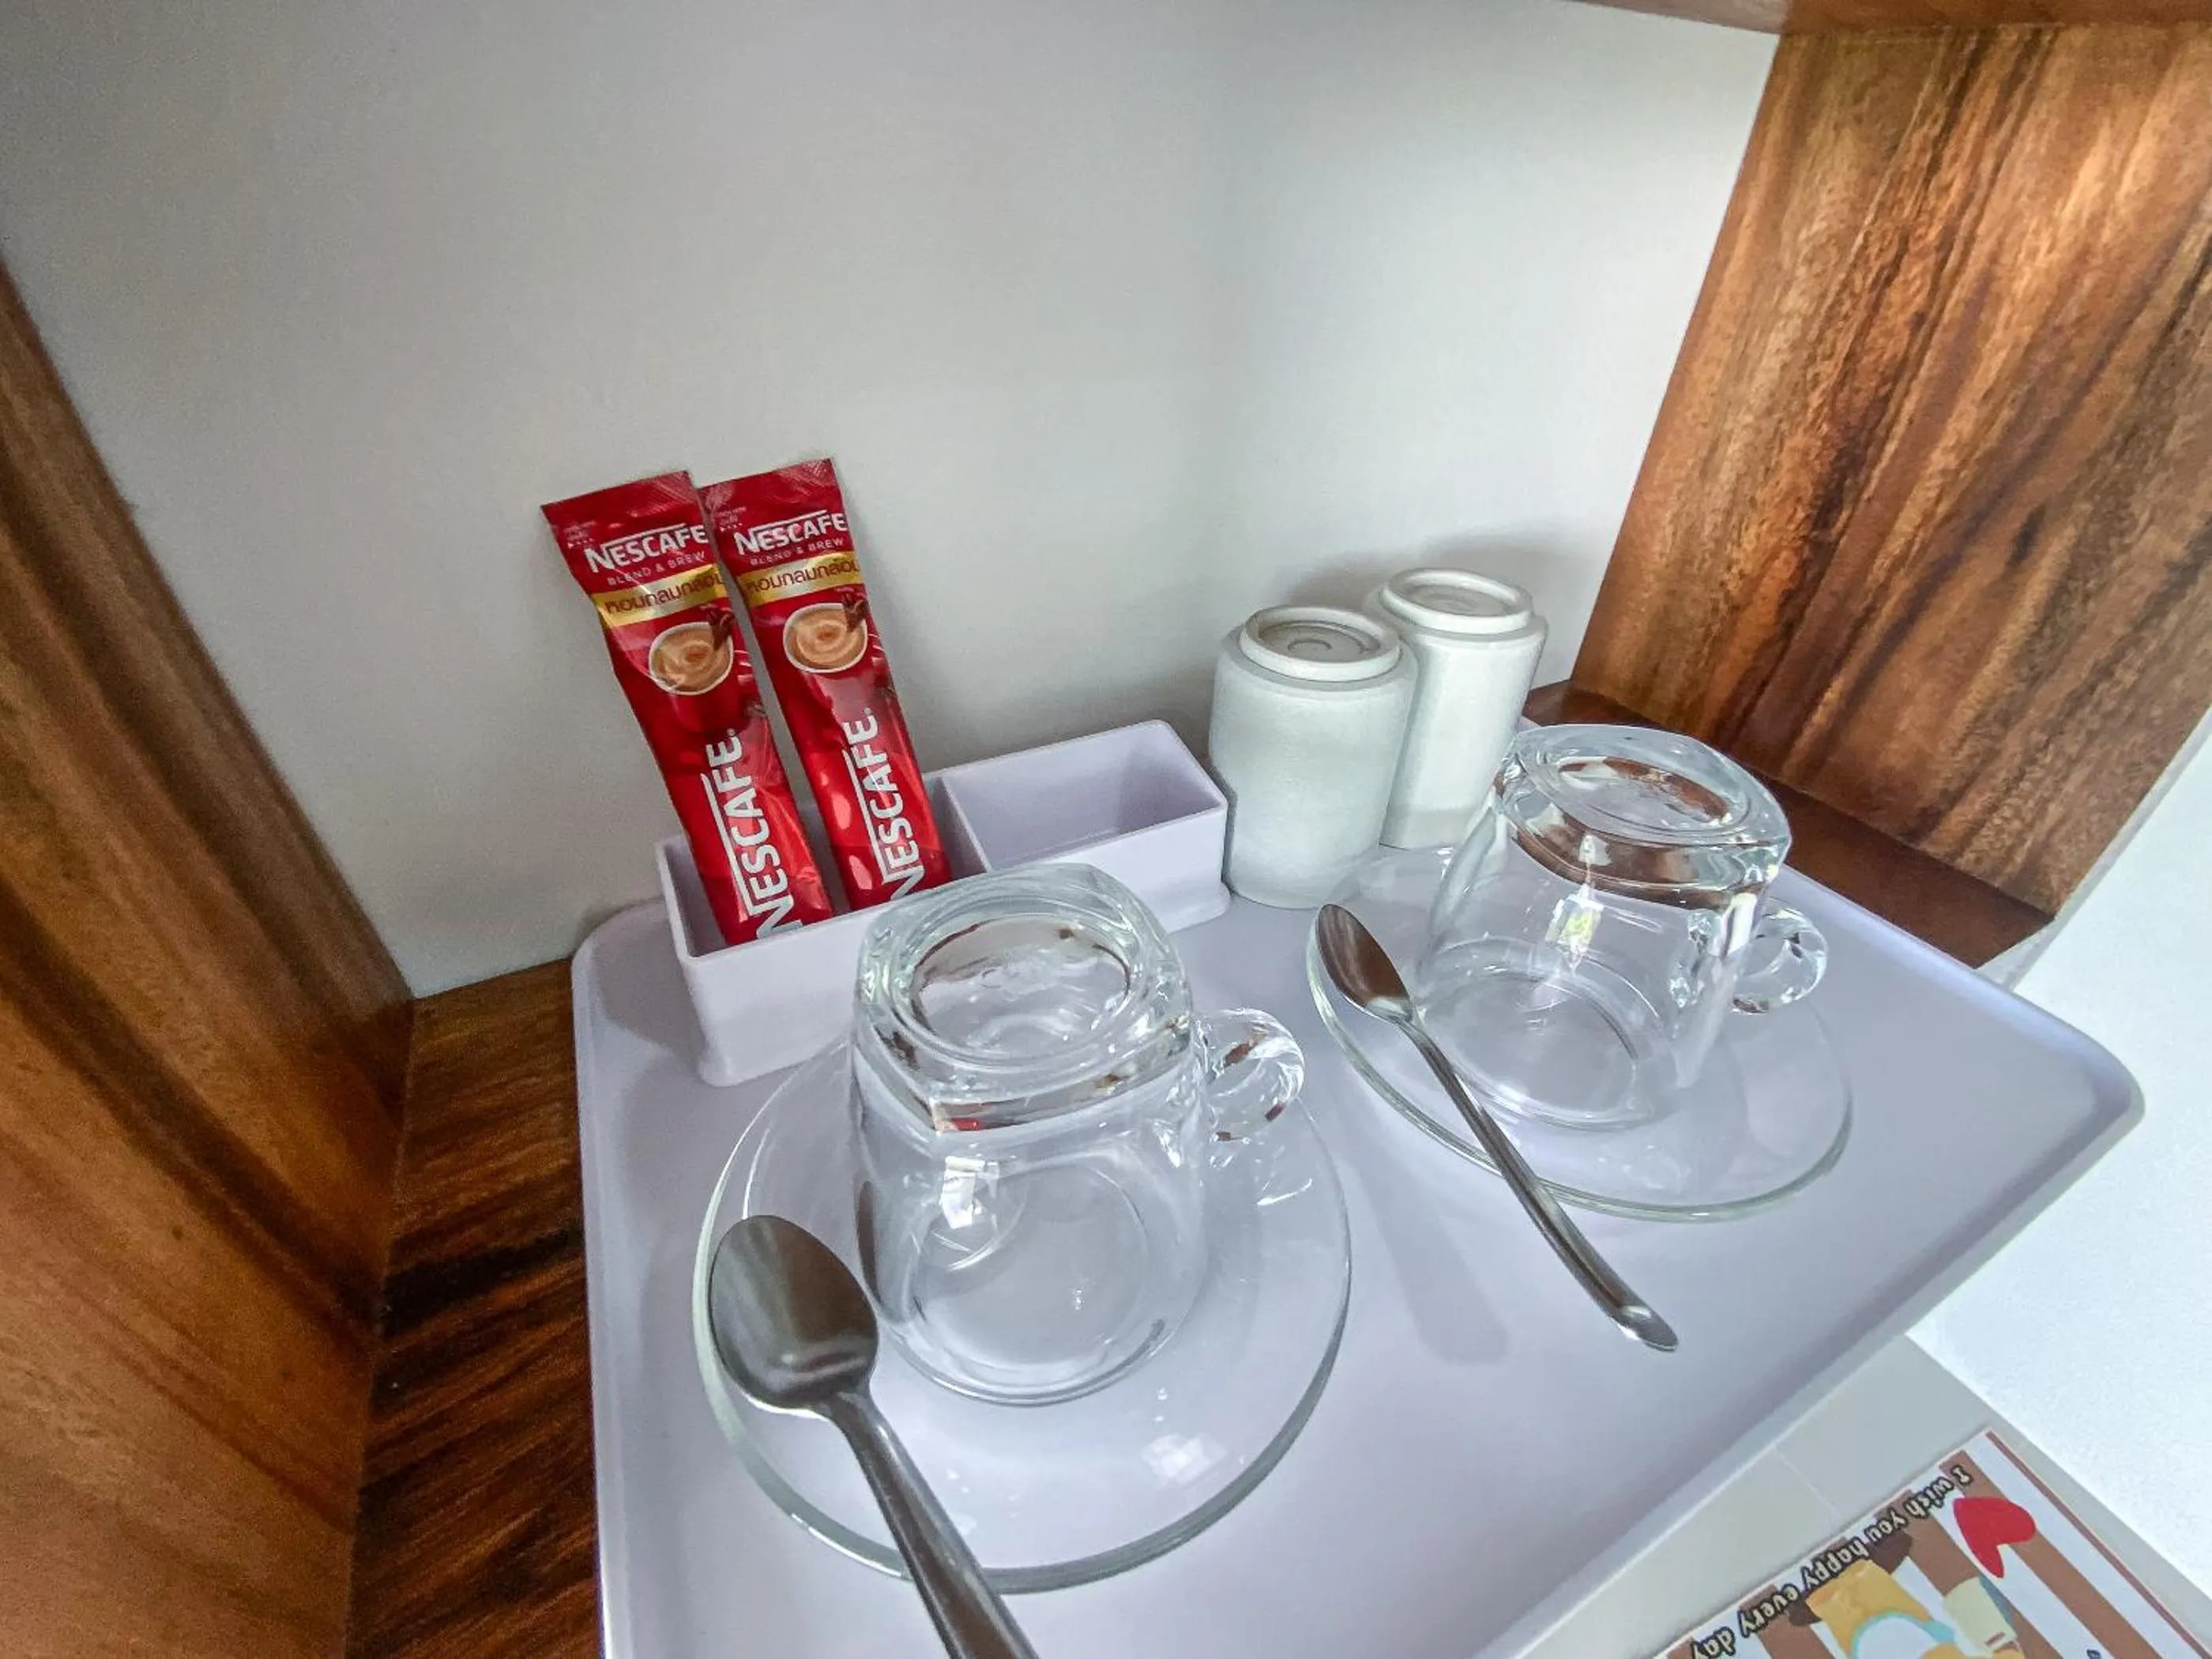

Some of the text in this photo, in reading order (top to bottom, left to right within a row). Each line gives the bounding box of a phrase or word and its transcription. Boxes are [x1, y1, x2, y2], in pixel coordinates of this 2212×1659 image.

[807, 537, 845, 552] BREW
[668, 551, 705, 570] BREW
[1691, 1465, 1973, 1659] I wish you happy every day
